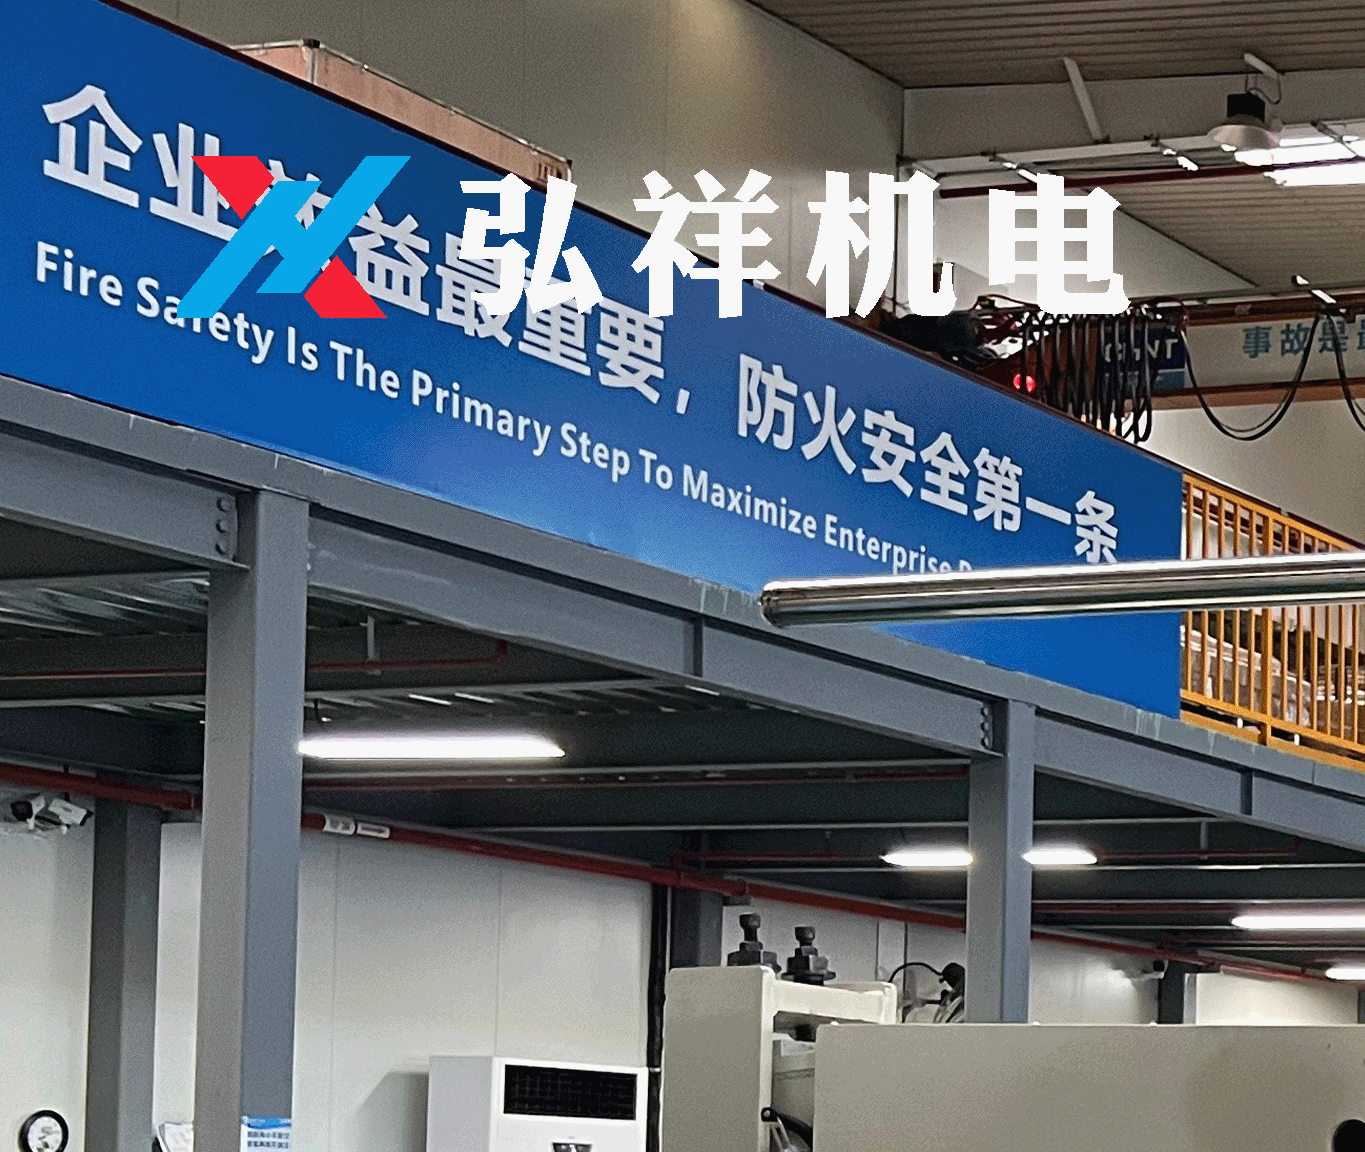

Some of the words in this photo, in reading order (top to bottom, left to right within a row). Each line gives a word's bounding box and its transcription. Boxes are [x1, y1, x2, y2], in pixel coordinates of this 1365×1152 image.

[36, 241, 123, 306] Fire
[287, 326, 319, 371] Is
[329, 341, 400, 399] The
[411, 369, 552, 457] Primary
[560, 422, 630, 483] Step
[638, 448, 673, 490] To
[682, 464, 817, 540] Maximize
[42, 84, 1119, 563] 企业益最重要，防火安全第一条
